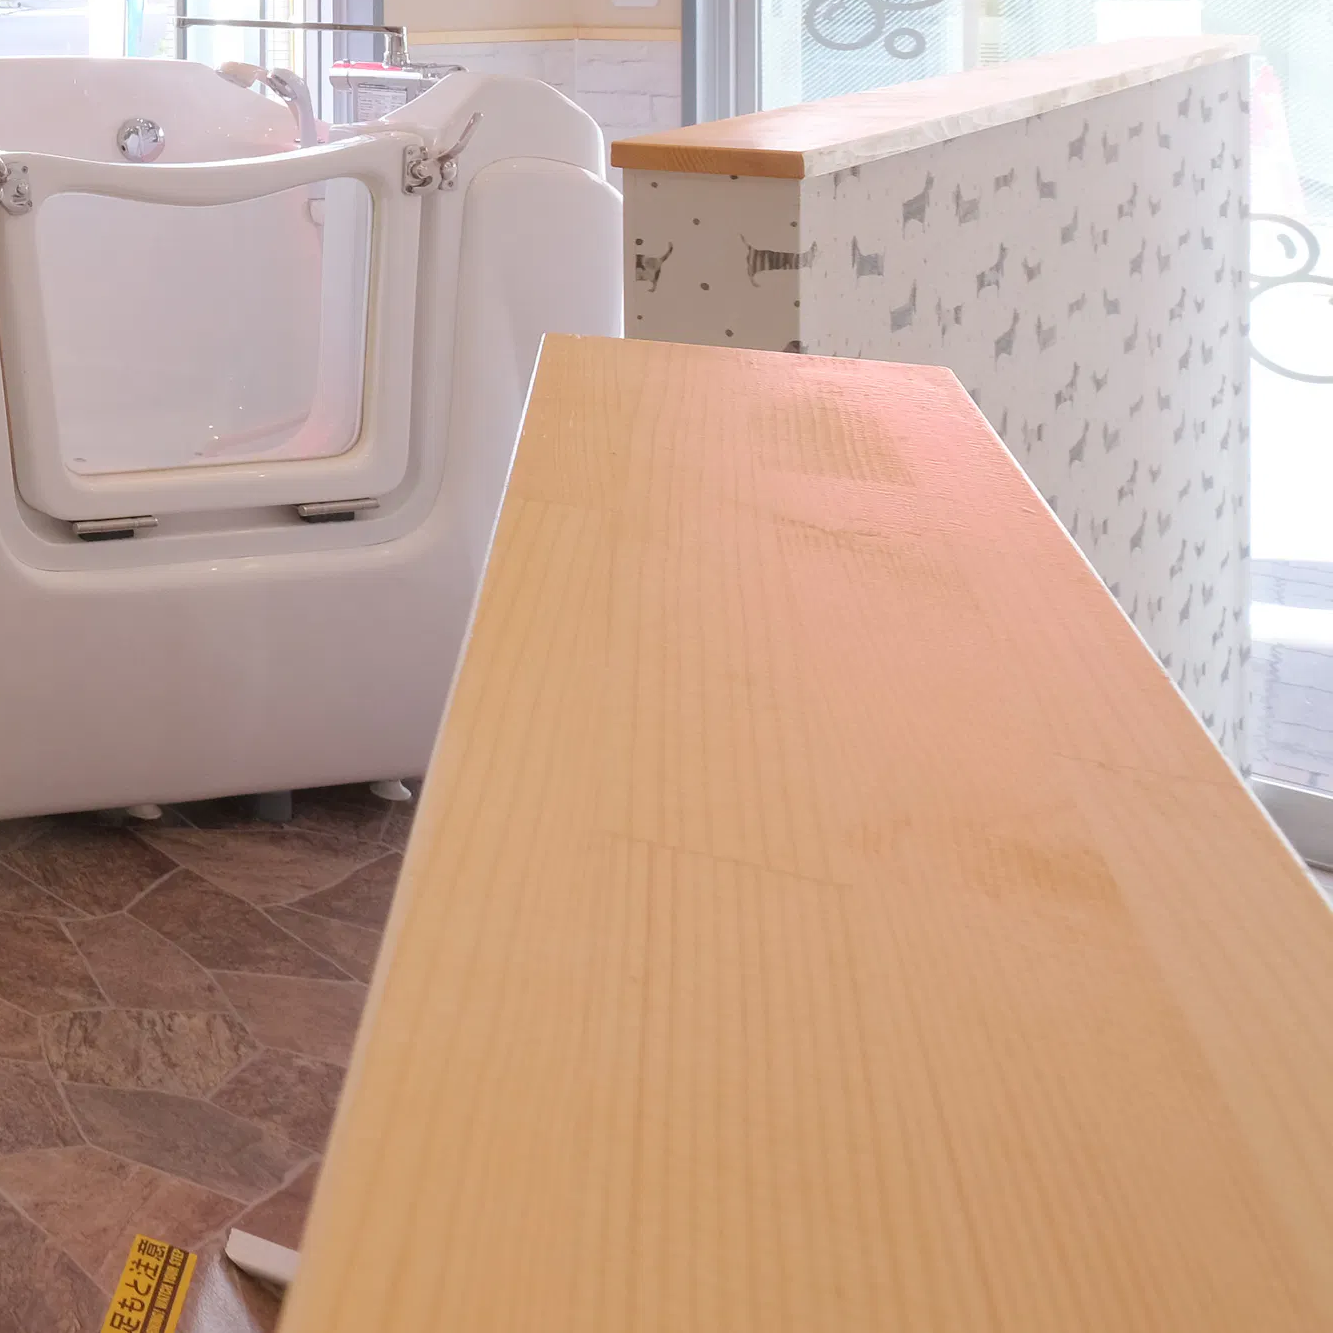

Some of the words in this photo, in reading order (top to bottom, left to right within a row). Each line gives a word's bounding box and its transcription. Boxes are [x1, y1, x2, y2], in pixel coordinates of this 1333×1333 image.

[109, 1238, 166, 1333] 足もと注意
